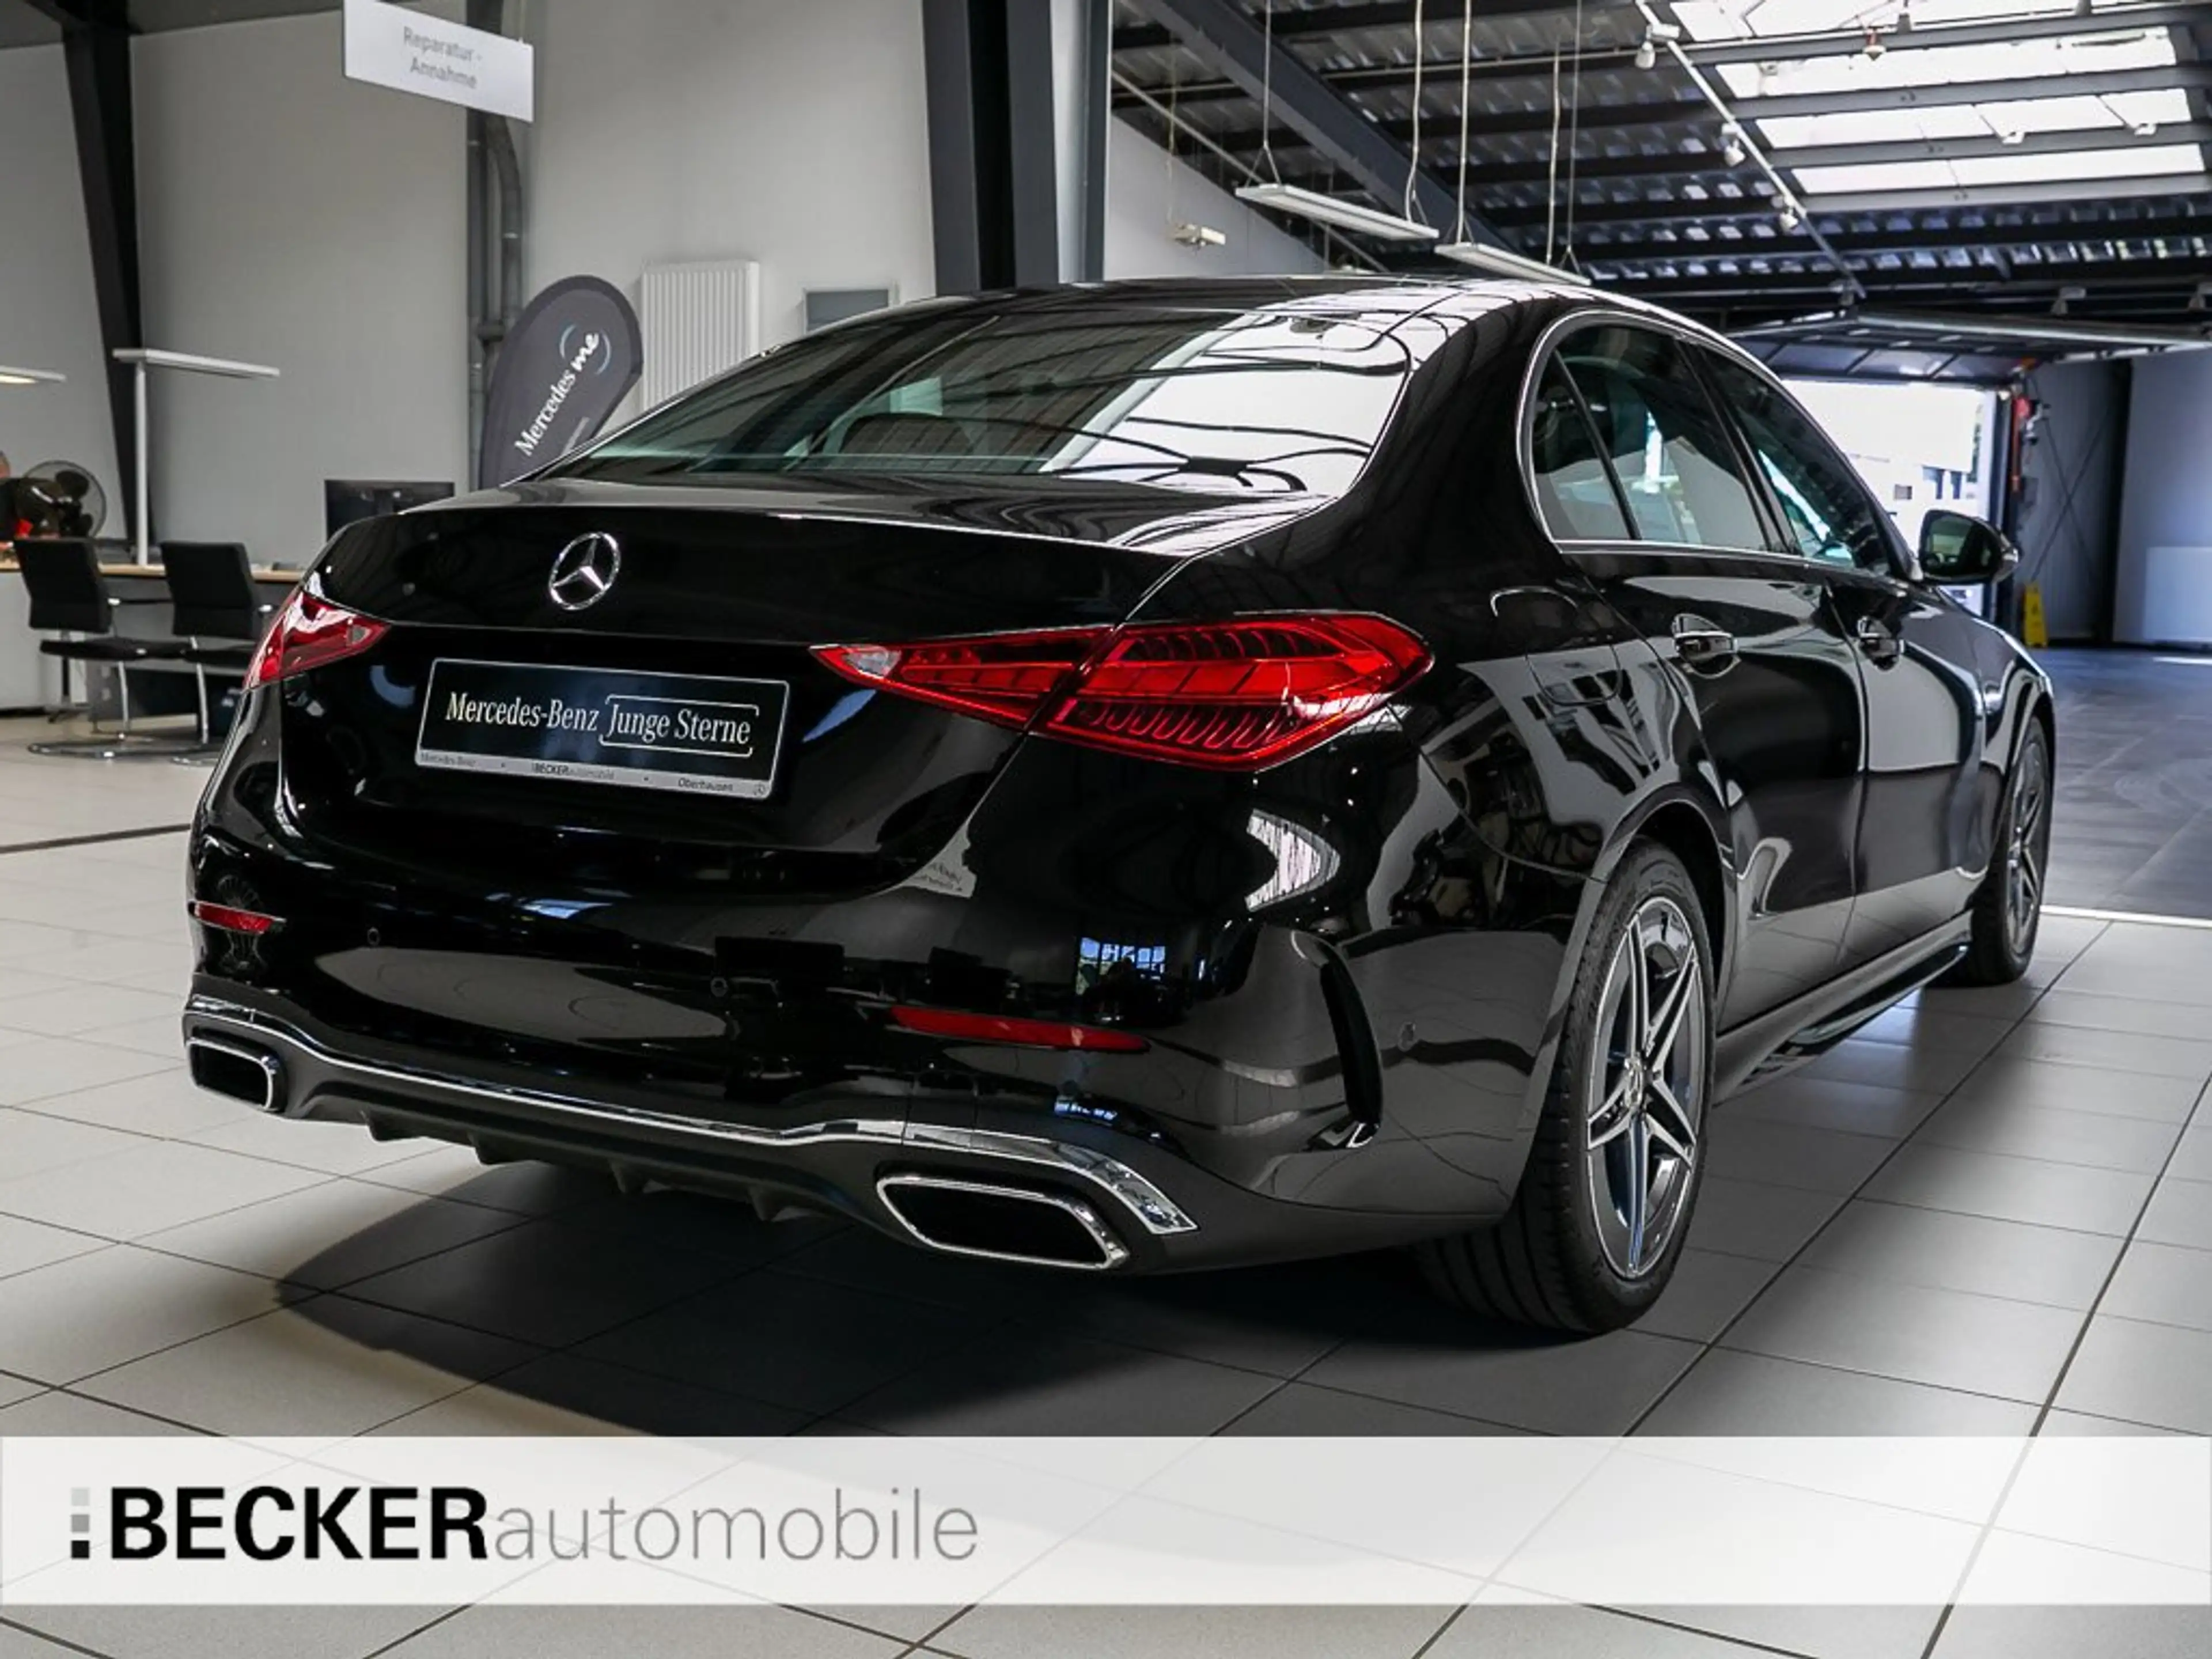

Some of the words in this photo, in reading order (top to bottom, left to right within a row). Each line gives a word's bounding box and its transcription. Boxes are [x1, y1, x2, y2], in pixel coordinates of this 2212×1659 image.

[403, 26, 474, 61] Reparatur
[409, 58, 477, 89] Annahme
[514, 370, 575, 456] Mercedes
[570, 333, 599, 371] me
[445, 692, 600, 732] Mercedes-Benz
[607, 704, 669, 743] Junge
[674, 709, 751, 744] Sterne
